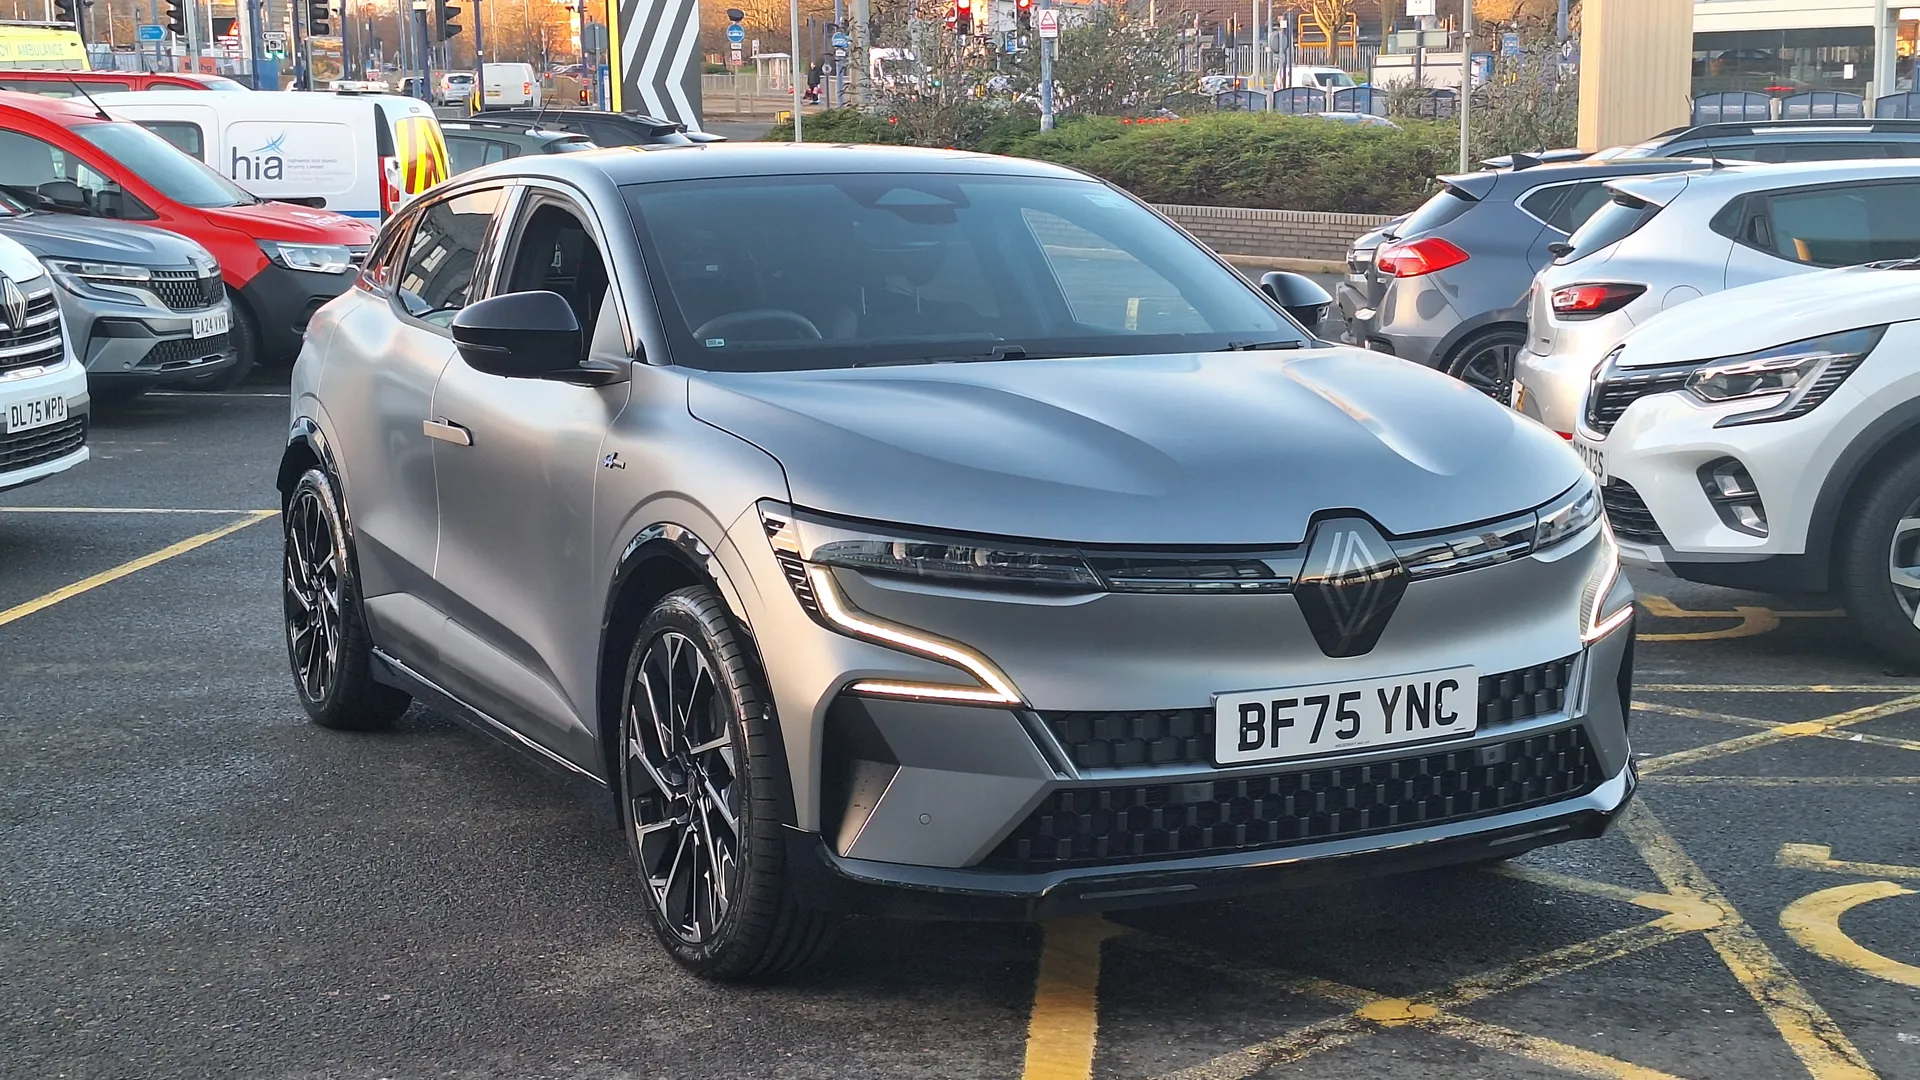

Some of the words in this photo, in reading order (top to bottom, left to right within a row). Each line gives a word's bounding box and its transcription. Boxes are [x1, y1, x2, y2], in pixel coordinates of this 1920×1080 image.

[17, 43, 65, 57] AMBULANCE
[231, 146, 283, 180] hia
[11, 401, 42, 427] DL75
[45, 396, 63, 420] WPD
[1588, 447, 1604, 478] TZS
[1238, 691, 1362, 752] BF75
[1377, 679, 1459, 734] YNC
